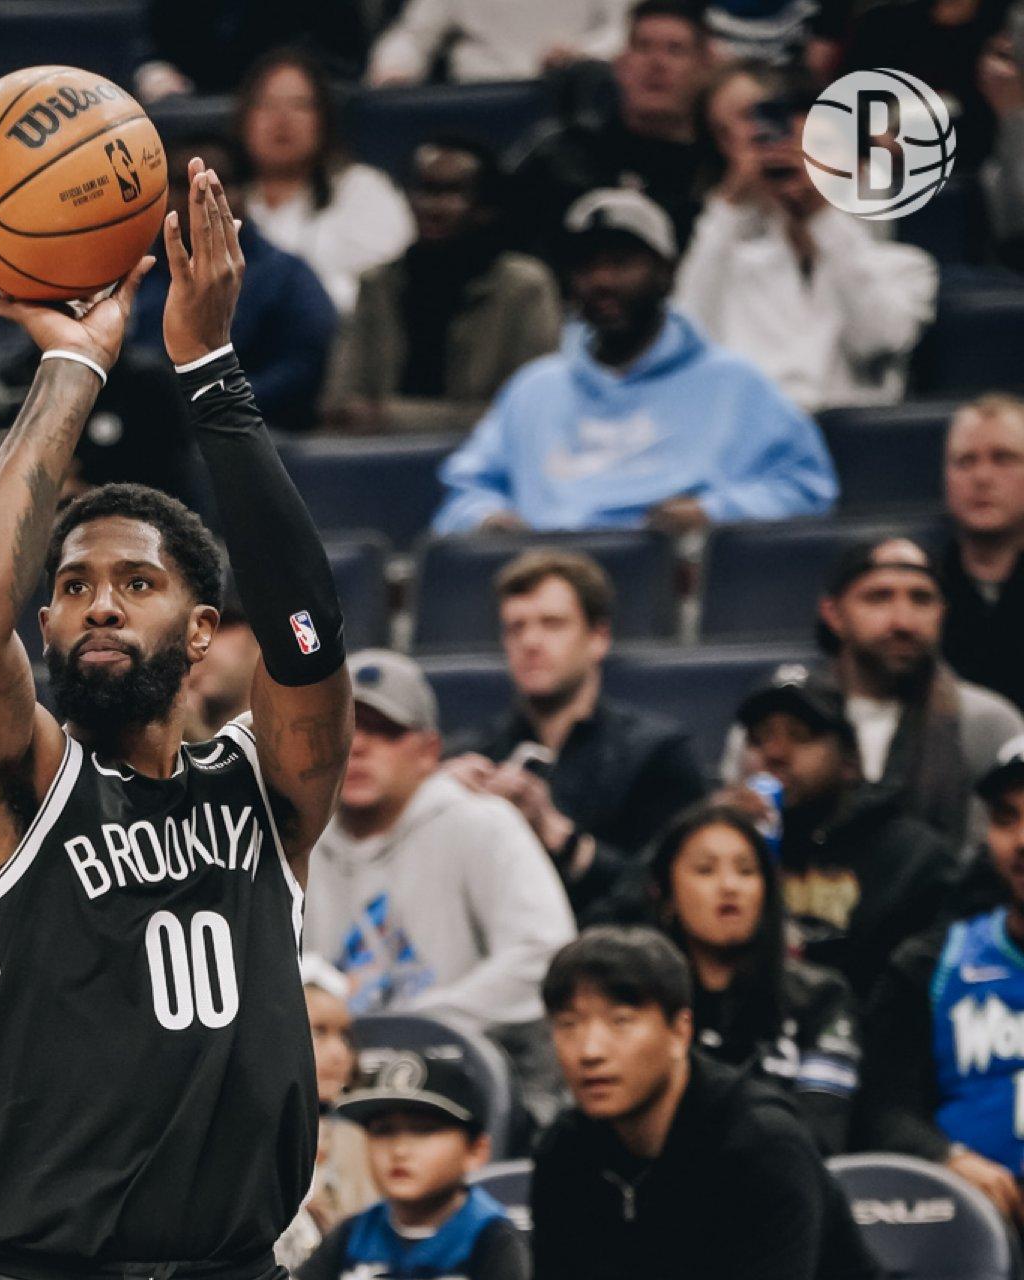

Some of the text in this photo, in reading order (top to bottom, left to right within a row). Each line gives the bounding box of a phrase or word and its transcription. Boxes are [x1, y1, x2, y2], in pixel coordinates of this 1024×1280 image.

[6, 84, 125, 149] Wilso
[64, 802, 263, 900] BROOKLYN
[145, 910, 239, 1030] 00
[851, 1198, 955, 1225] EXUS
